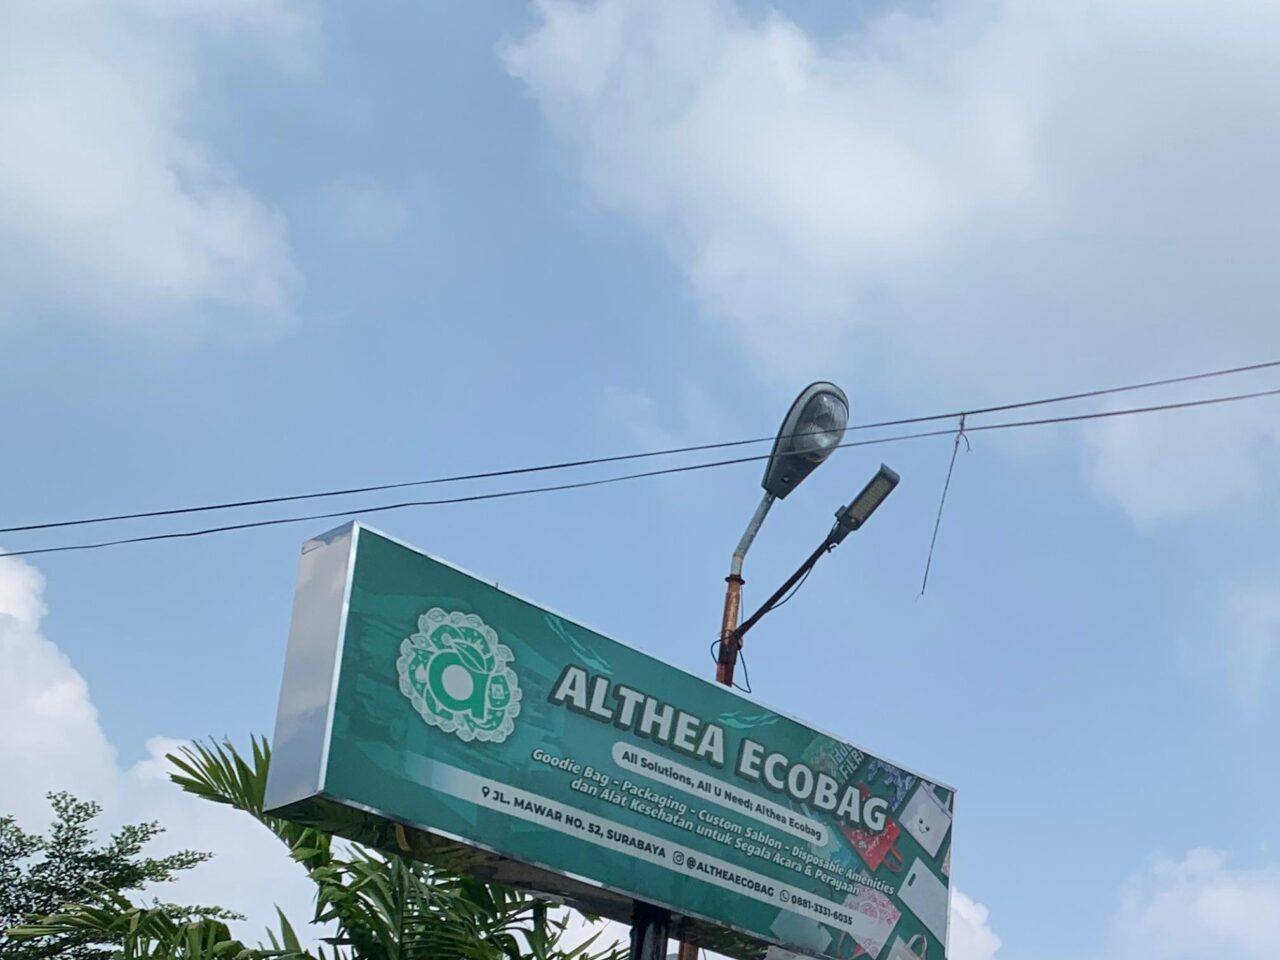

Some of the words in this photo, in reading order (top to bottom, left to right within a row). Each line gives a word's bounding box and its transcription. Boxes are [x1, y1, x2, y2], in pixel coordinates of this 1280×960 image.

[553, 666, 725, 765] ALTHEA
[738, 738, 889, 832] ECOBAG
[622, 750, 638, 765] All
[640, 758, 695, 788] Solutions,
[697, 779, 712, 794] All
[714, 785, 722, 797] U
[755, 803, 786, 825] Althea
[788, 817, 822, 841] Ecobag
[492, 790, 510, 806] JL.
[513, 796, 562, 822] MAWAR
[565, 814, 585, 831] NO.
[587, 821, 604, 838] 52,
[606, 828, 666, 859] SURABAYA
[686, 856, 775, 897] @ALTHEAECOBAG
[532, 748, 581, 775] Goodie
[583, 765, 611, 787] Bag
[621, 779, 688, 816] Packaging
[698, 809, 742, 835] Custom
[745, 827, 782, 850] Sablon
[792, 845, 845, 876] Disposable
[846, 868, 895, 895] Amenities
[571, 778, 603, 797] dan
[600, 788, 629, 809] Alat
[630, 796, 694, 831] Kesehatan
[696, 822, 732, 846] untuk
[734, 838, 771, 862] Segala
[772, 853, 802, 873] Acara
[804, 865, 812, 876] &
[814, 869, 860, 896] Perayaan
